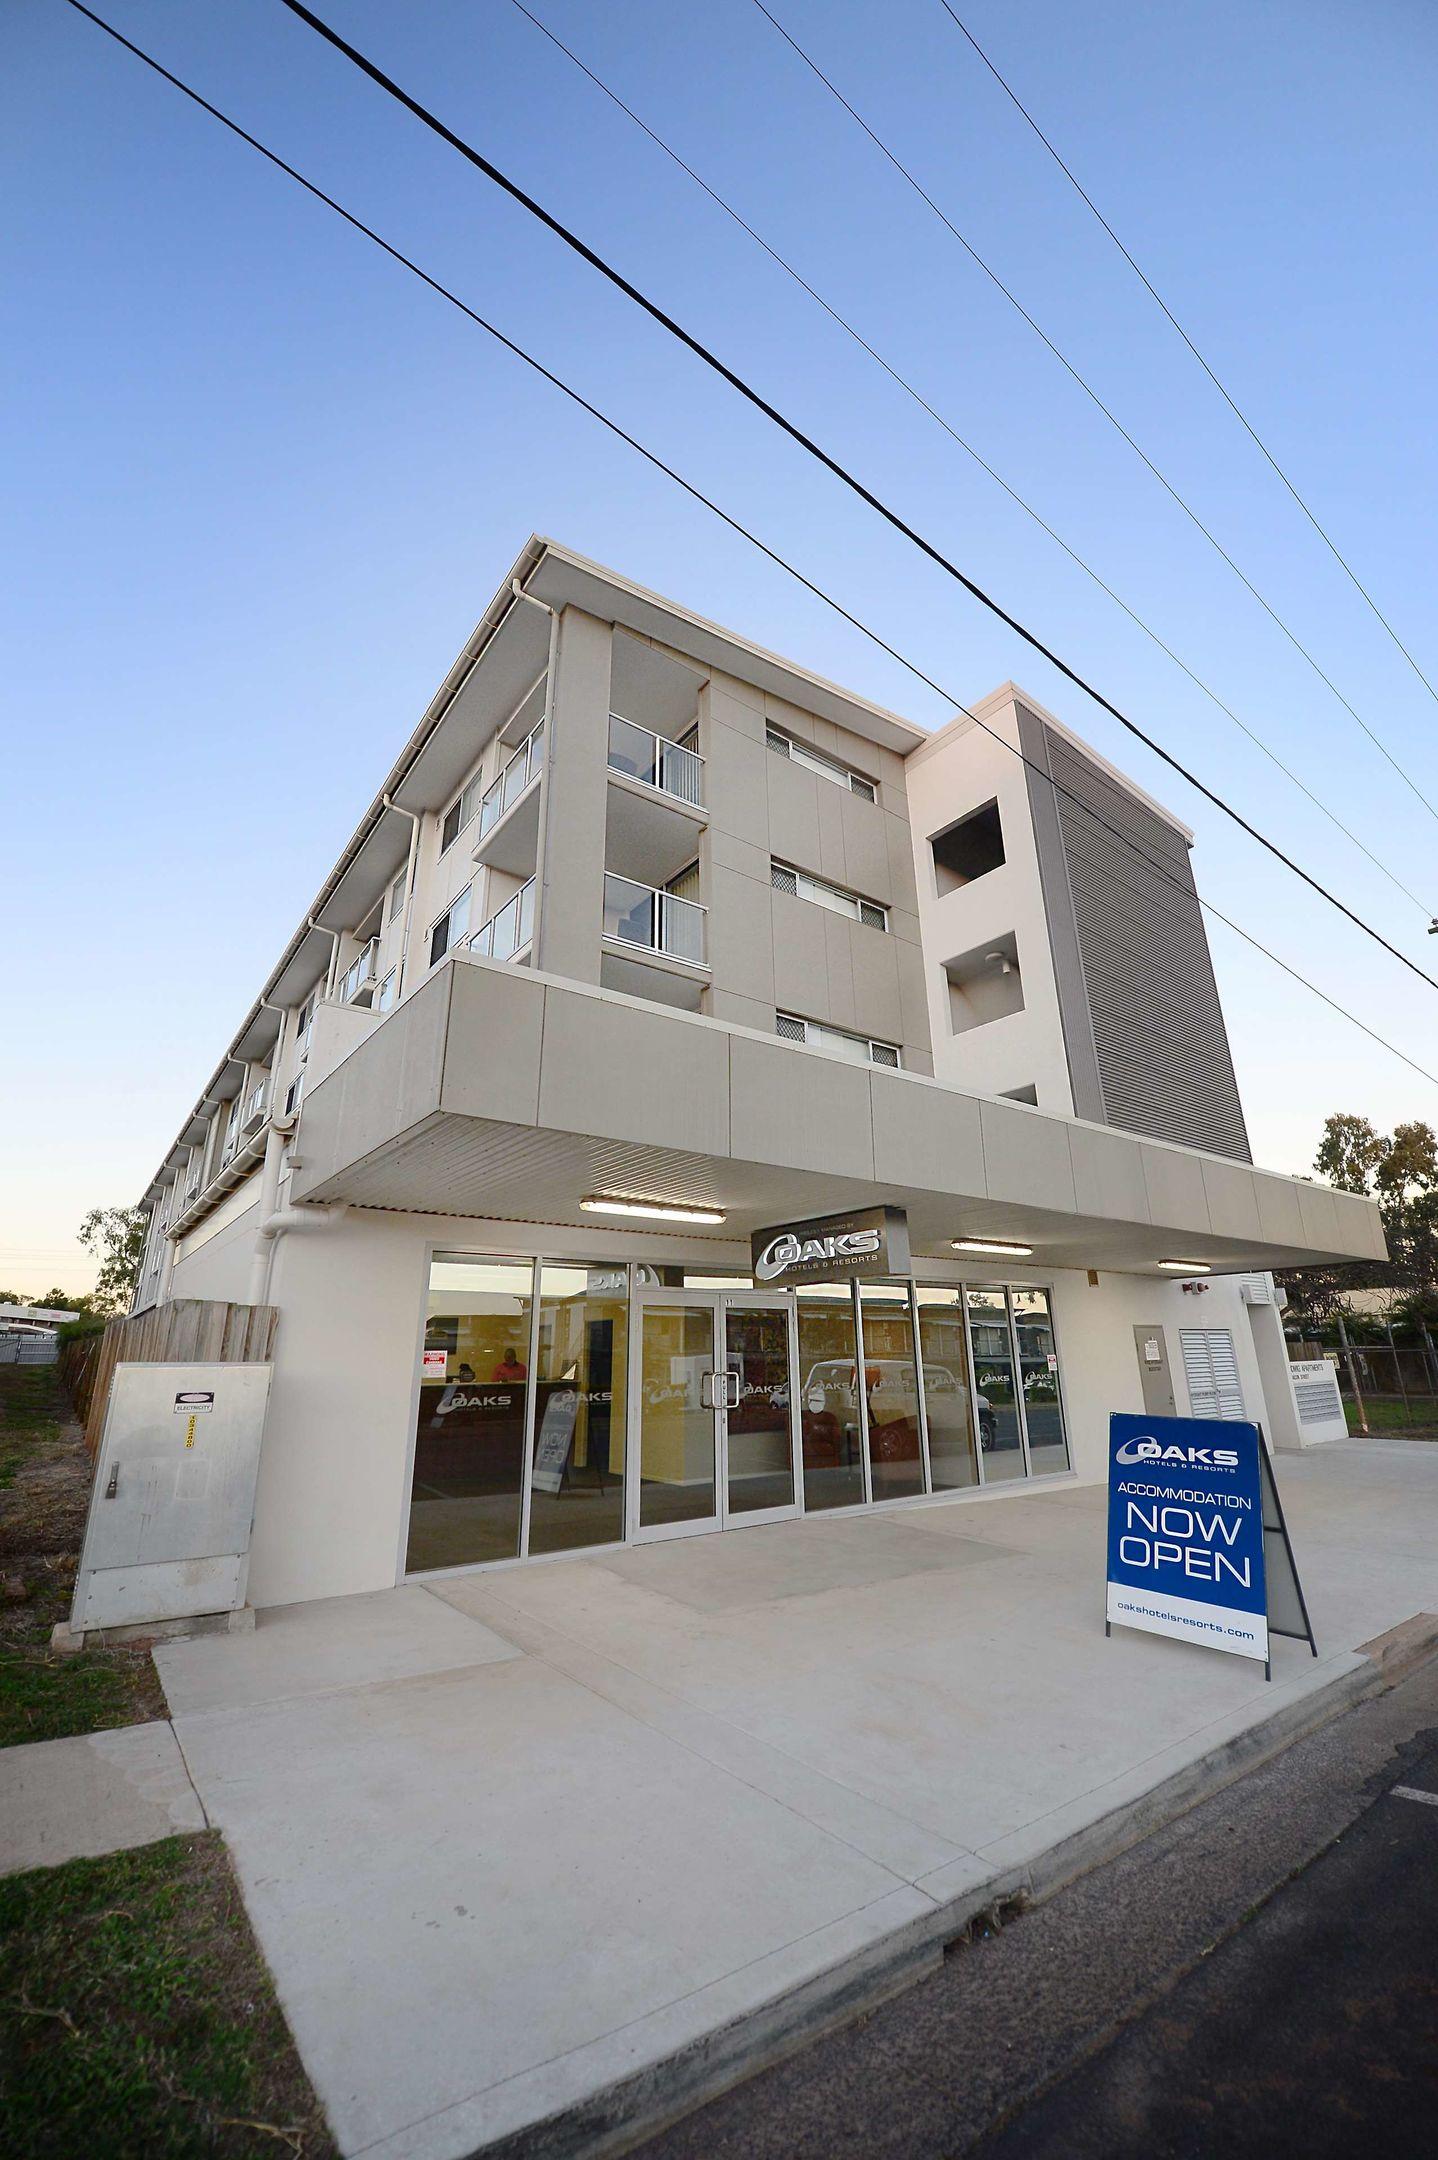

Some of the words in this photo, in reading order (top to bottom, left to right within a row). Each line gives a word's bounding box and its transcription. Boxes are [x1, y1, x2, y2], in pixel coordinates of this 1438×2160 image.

[773, 1229, 880, 1263] OAKS
[786, 1264, 818, 1273] HOTELS
[833, 1254, 878, 1266] RESORTS
[451, 1395, 512, 1408] OAKS
[561, 1391, 613, 1402] OAKS
[743, 1384, 783, 1395] OAKS
[1137, 1442, 1239, 1466] OAKS
[1143, 1459, 1178, 1468] HOTELS
[1191, 1464, 1236, 1474] RESORTS
[1117, 1481, 1252, 1510] ACCOMMODATION
[1127, 1501, 1242, 1546] NOW
[1119, 1535, 1251, 1588] OPEN
[1117, 1601, 1255, 1641] oakshotelsresorts.com
